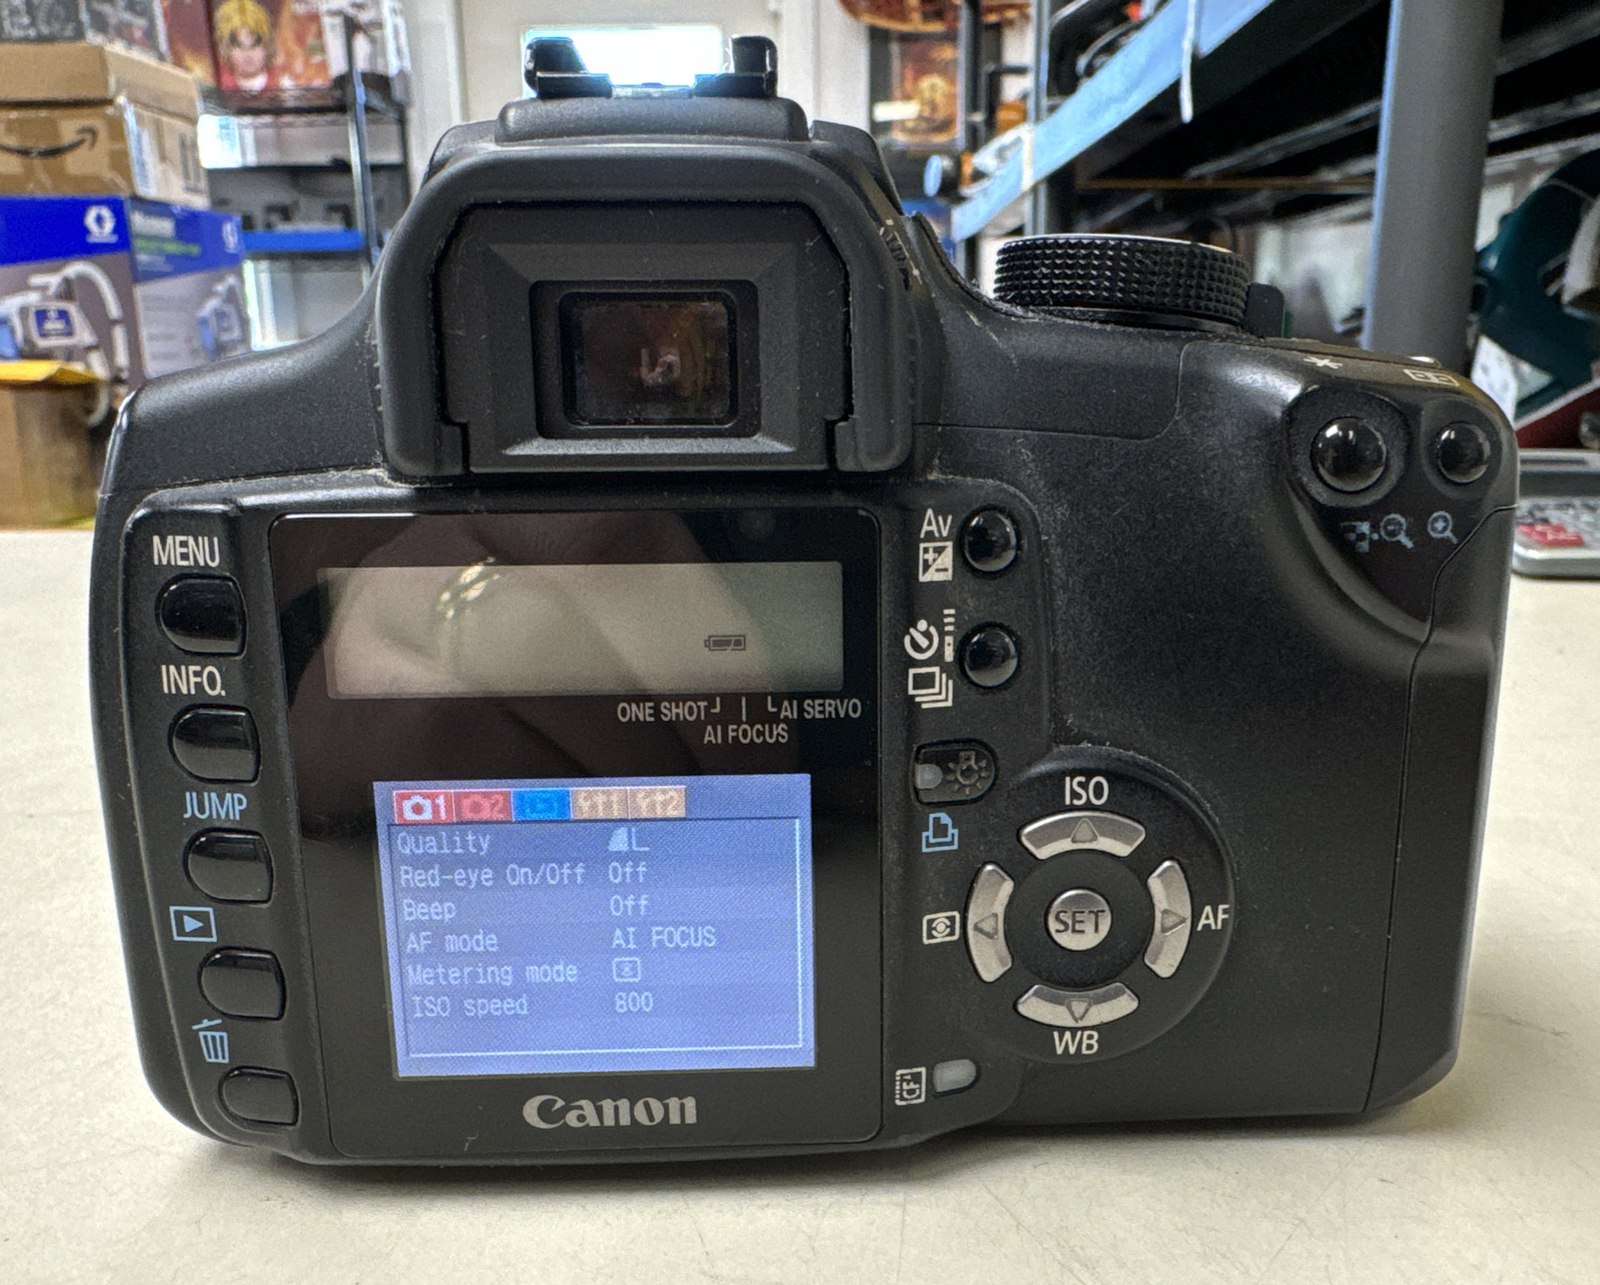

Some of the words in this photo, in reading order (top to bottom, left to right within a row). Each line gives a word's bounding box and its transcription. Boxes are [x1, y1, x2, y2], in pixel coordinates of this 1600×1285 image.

[920, 508, 953, 539] Av
[152, 535, 221, 568] MENU
[160, 664, 227, 697] INFO.
[617, 702, 655, 723] ONE
[660, 701, 708, 722] SHOT
[780, 700, 798, 720] AI
[803, 698, 862, 719] SERVO
[703, 725, 722, 745] AI
[727, 724, 789, 744] FOCUS
[1064, 776, 1110, 806] ISO
[183, 791, 248, 821] JUMP
[397, 830, 492, 856] Quality
[400, 863, 494, 889] Red-eye
[505, 861, 586, 886] On/Off
[608, 861, 650, 884] Off
[403, 899, 456, 922] Beep
[610, 895, 649, 917] Off
[1197, 904, 1230, 932] AF
[1054, 908, 1106, 935] SET
[406, 931, 432, 954] AF
[444, 930, 499, 953] mode
[612, 927, 637, 949] AI
[651, 926, 717, 948] FOCUS
[406, 964, 514, 987] Metering
[525, 961, 579, 984] mode
[410, 996, 452, 1018] ISO
[463, 994, 530, 1018] speed
[614, 992, 654, 1014] 800
[1053, 1031, 1099, 1055] WB
[523, 1094, 697, 1129] Canon
